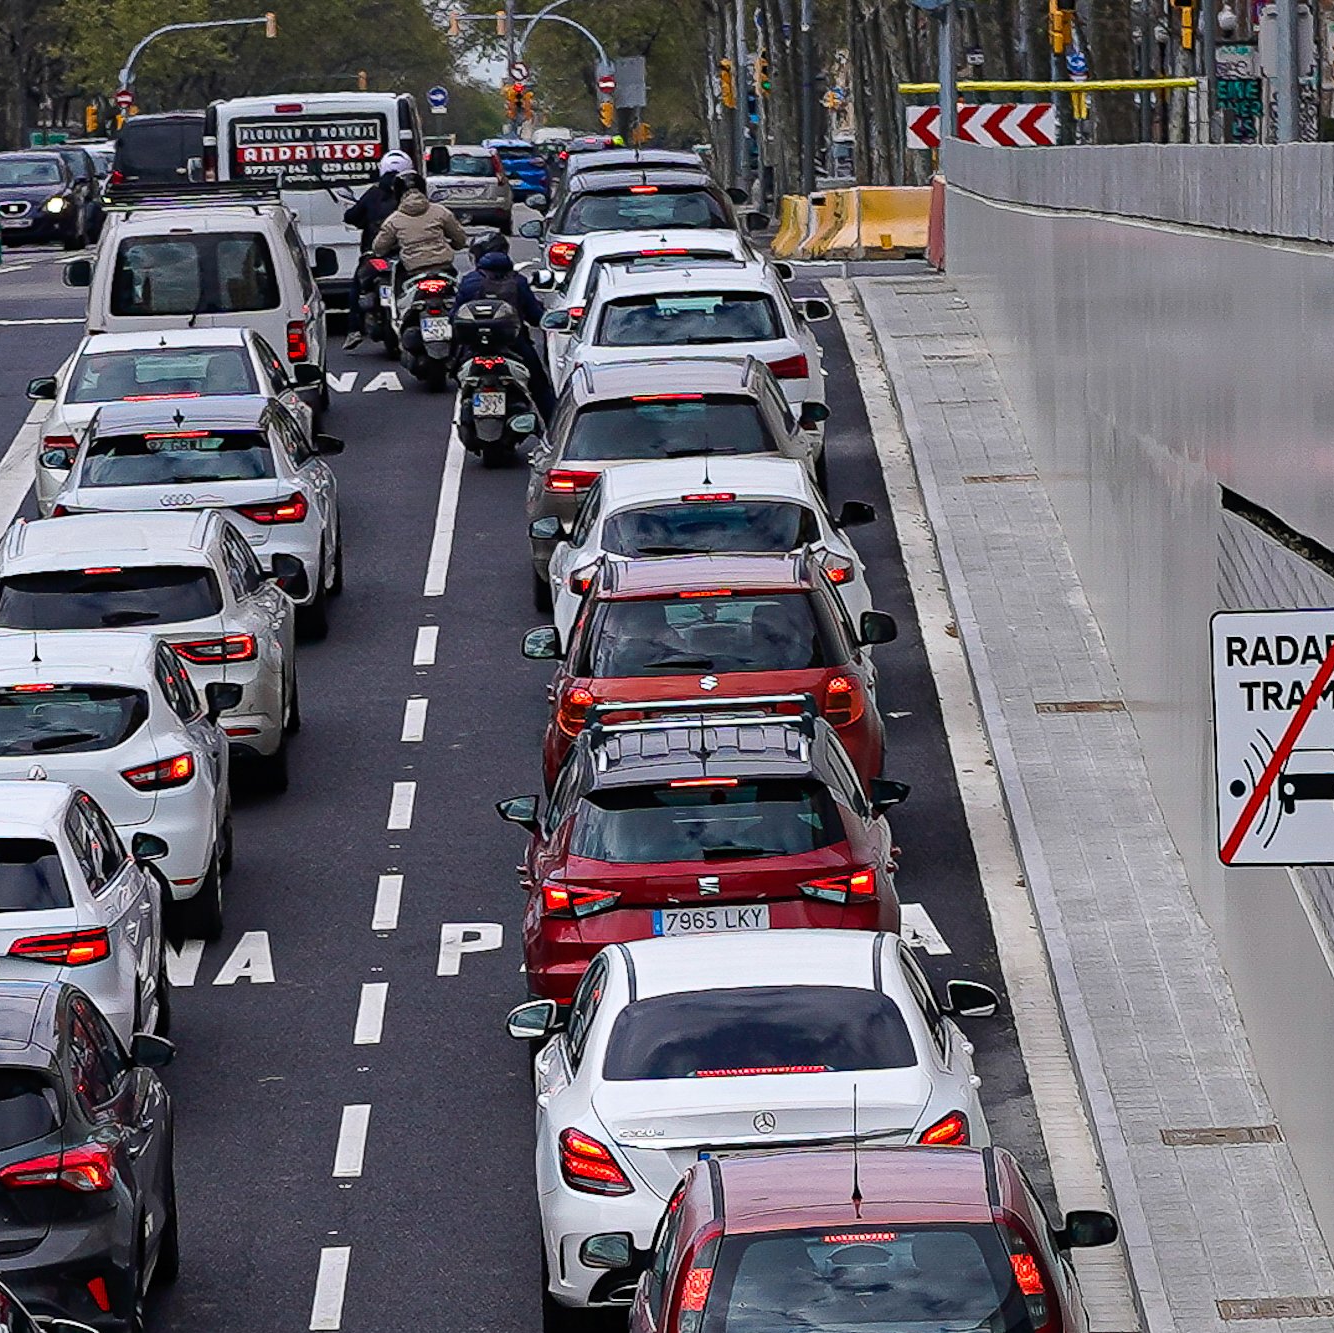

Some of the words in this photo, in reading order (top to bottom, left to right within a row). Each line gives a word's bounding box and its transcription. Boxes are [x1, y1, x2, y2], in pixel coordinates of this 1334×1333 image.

[243, 145, 375, 162] ANDAMIOS
[666, 911, 718, 932] 7965
[724, 908, 762, 929] LKY
